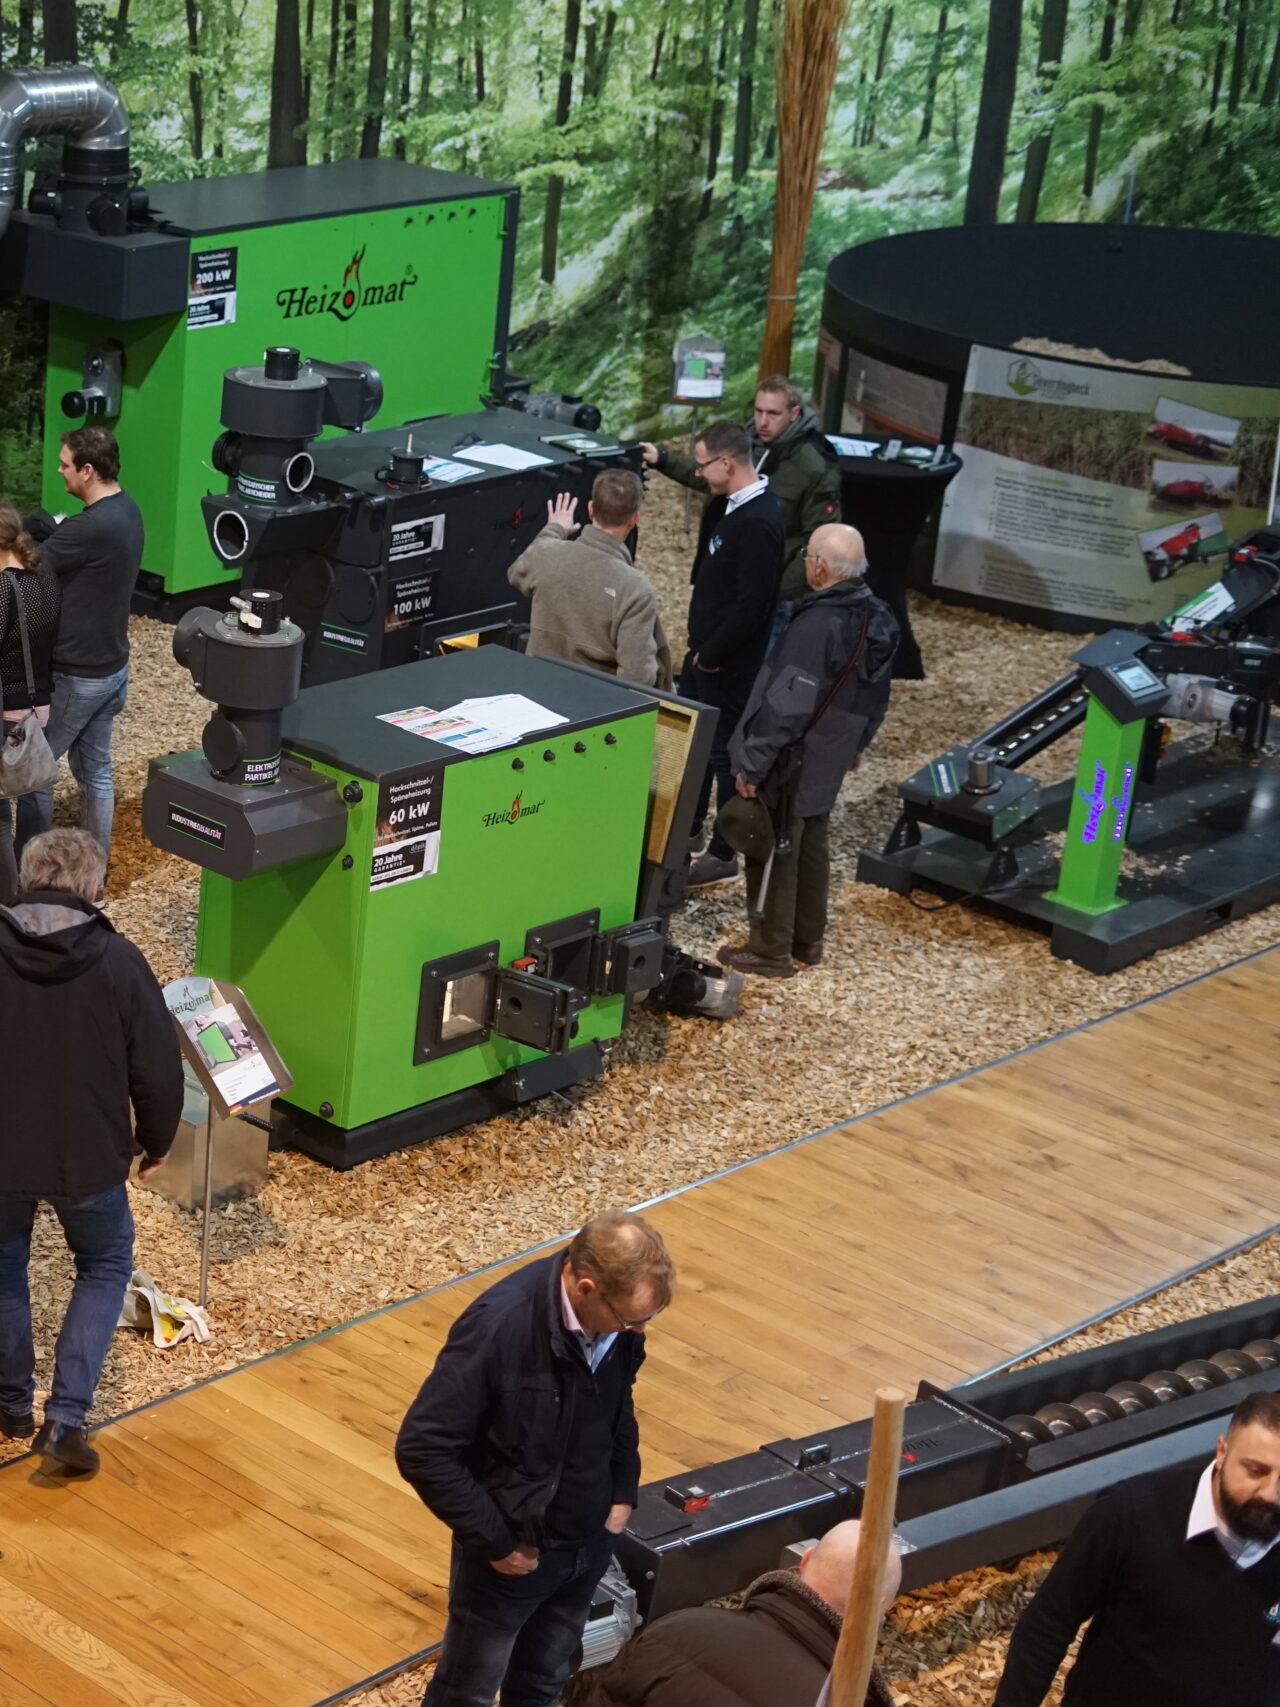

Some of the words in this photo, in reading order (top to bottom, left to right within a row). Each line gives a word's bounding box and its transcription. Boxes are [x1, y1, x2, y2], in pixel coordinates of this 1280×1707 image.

[196, 271, 213, 284] 200
[215, 269, 231, 281] kW
[276, 268, 418, 322] Heizomat
[394, 600, 412, 615] 100
[414, 596, 432, 610] kW
[389, 808, 405, 825] 60
[408, 801, 430, 820] kW
[482, 798, 546, 827] Heizomat
[374, 857, 384, 867] 20
[384, 853, 403, 864] Jahre
